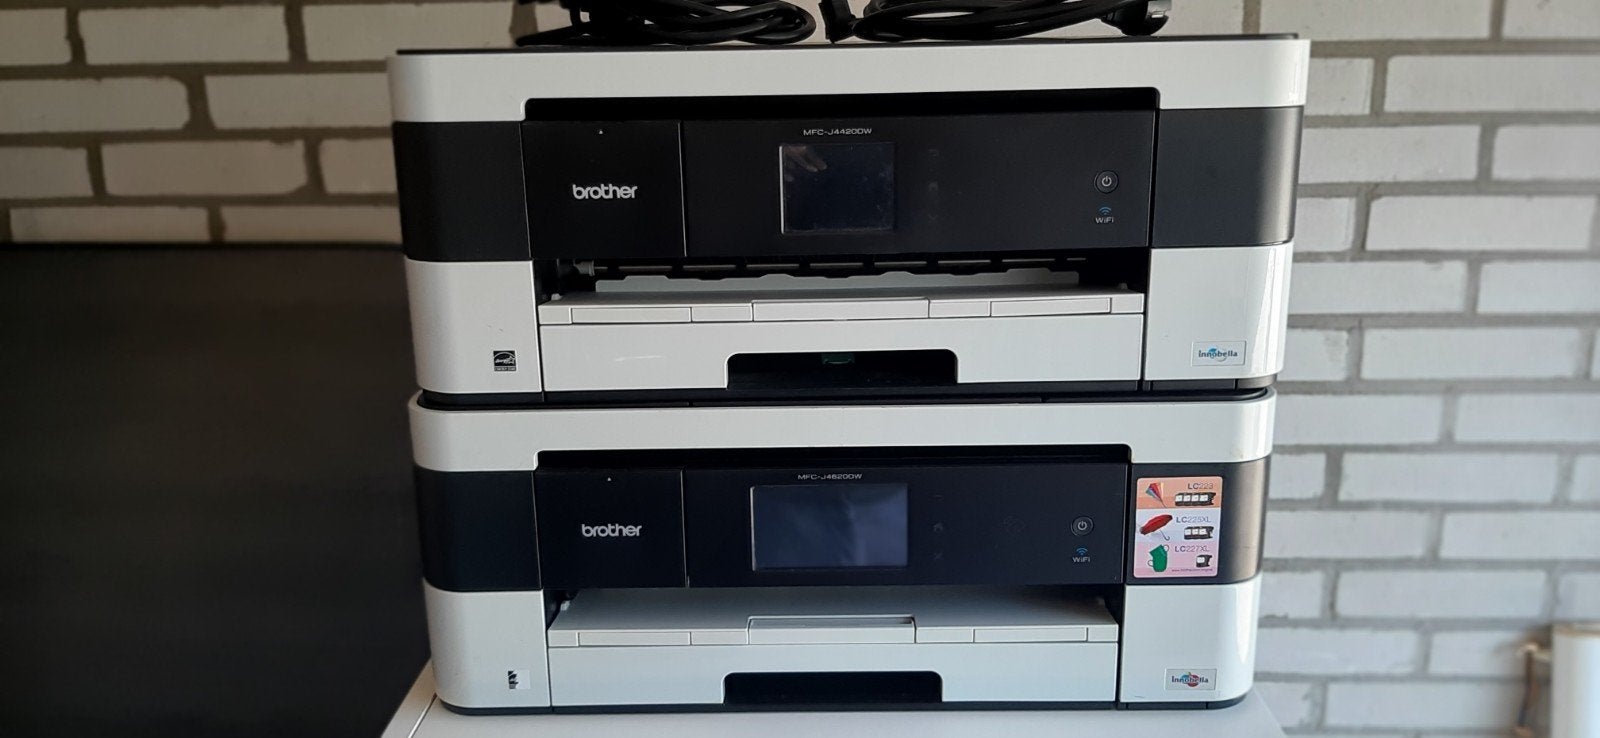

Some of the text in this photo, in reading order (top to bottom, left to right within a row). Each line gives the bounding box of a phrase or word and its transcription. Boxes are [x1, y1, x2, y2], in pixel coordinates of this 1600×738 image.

[572, 183, 638, 200] brother
[1198, 349, 1238, 358] Innobella
[581, 523, 643, 538] brother
[1174, 545, 1210, 553] LC227XL
[1171, 675, 1209, 684] Innobella
